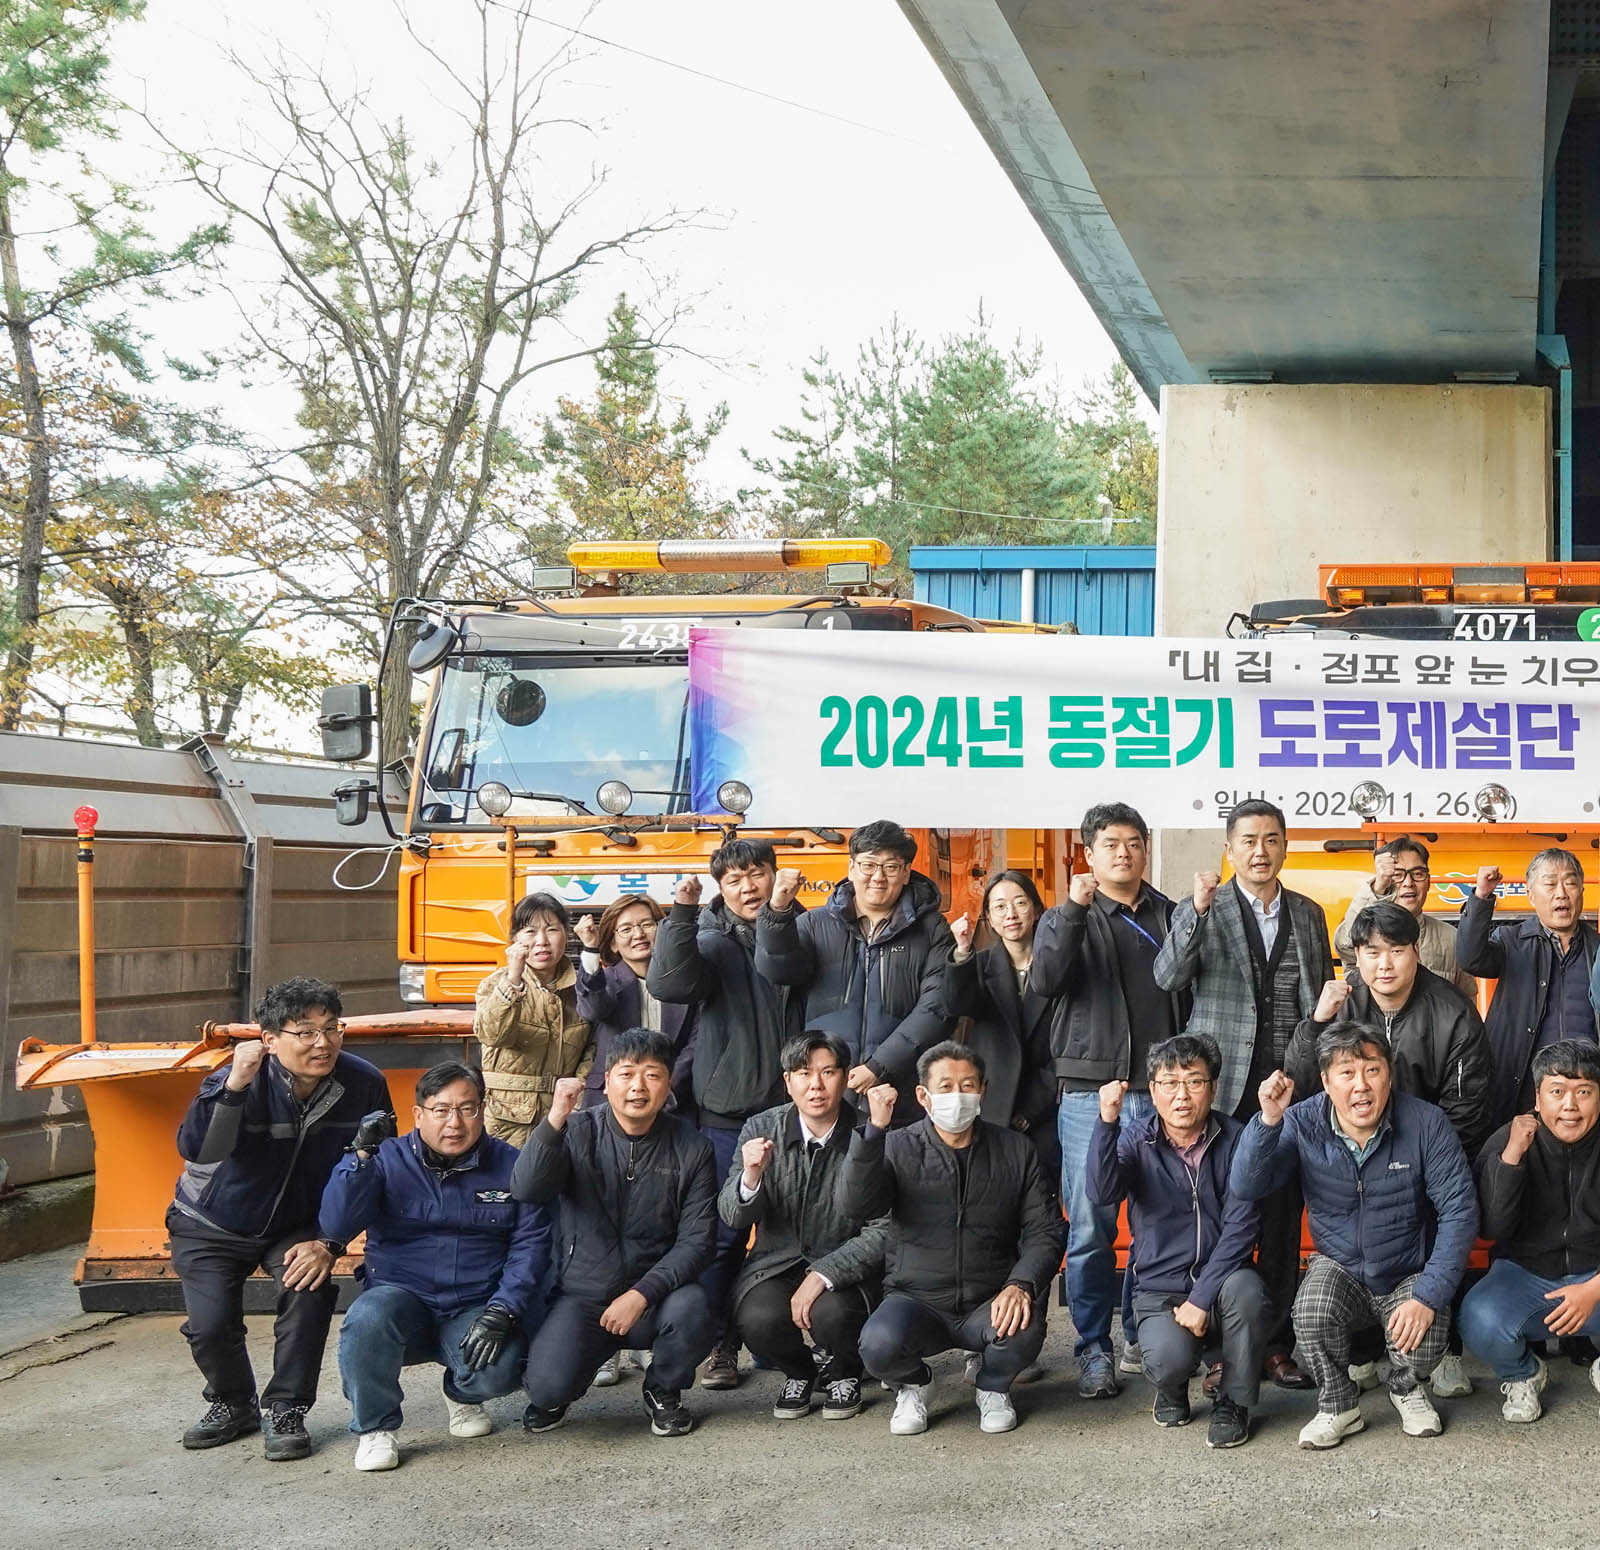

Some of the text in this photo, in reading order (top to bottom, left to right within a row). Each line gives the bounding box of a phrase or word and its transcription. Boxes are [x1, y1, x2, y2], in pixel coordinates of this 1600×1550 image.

[1454, 614, 1535, 640] 4071
[1236, 651, 1272, 683] 집
[1321, 652, 1401, 684] 점포
[1415, 654, 1455, 684] 앞
[1468, 657, 1508, 685] 눈
[819, 695, 1024, 769] 2024년
[1048, 695, 1235, 769] 동절기
[1259, 699, 1580, 771] 도로제설단
